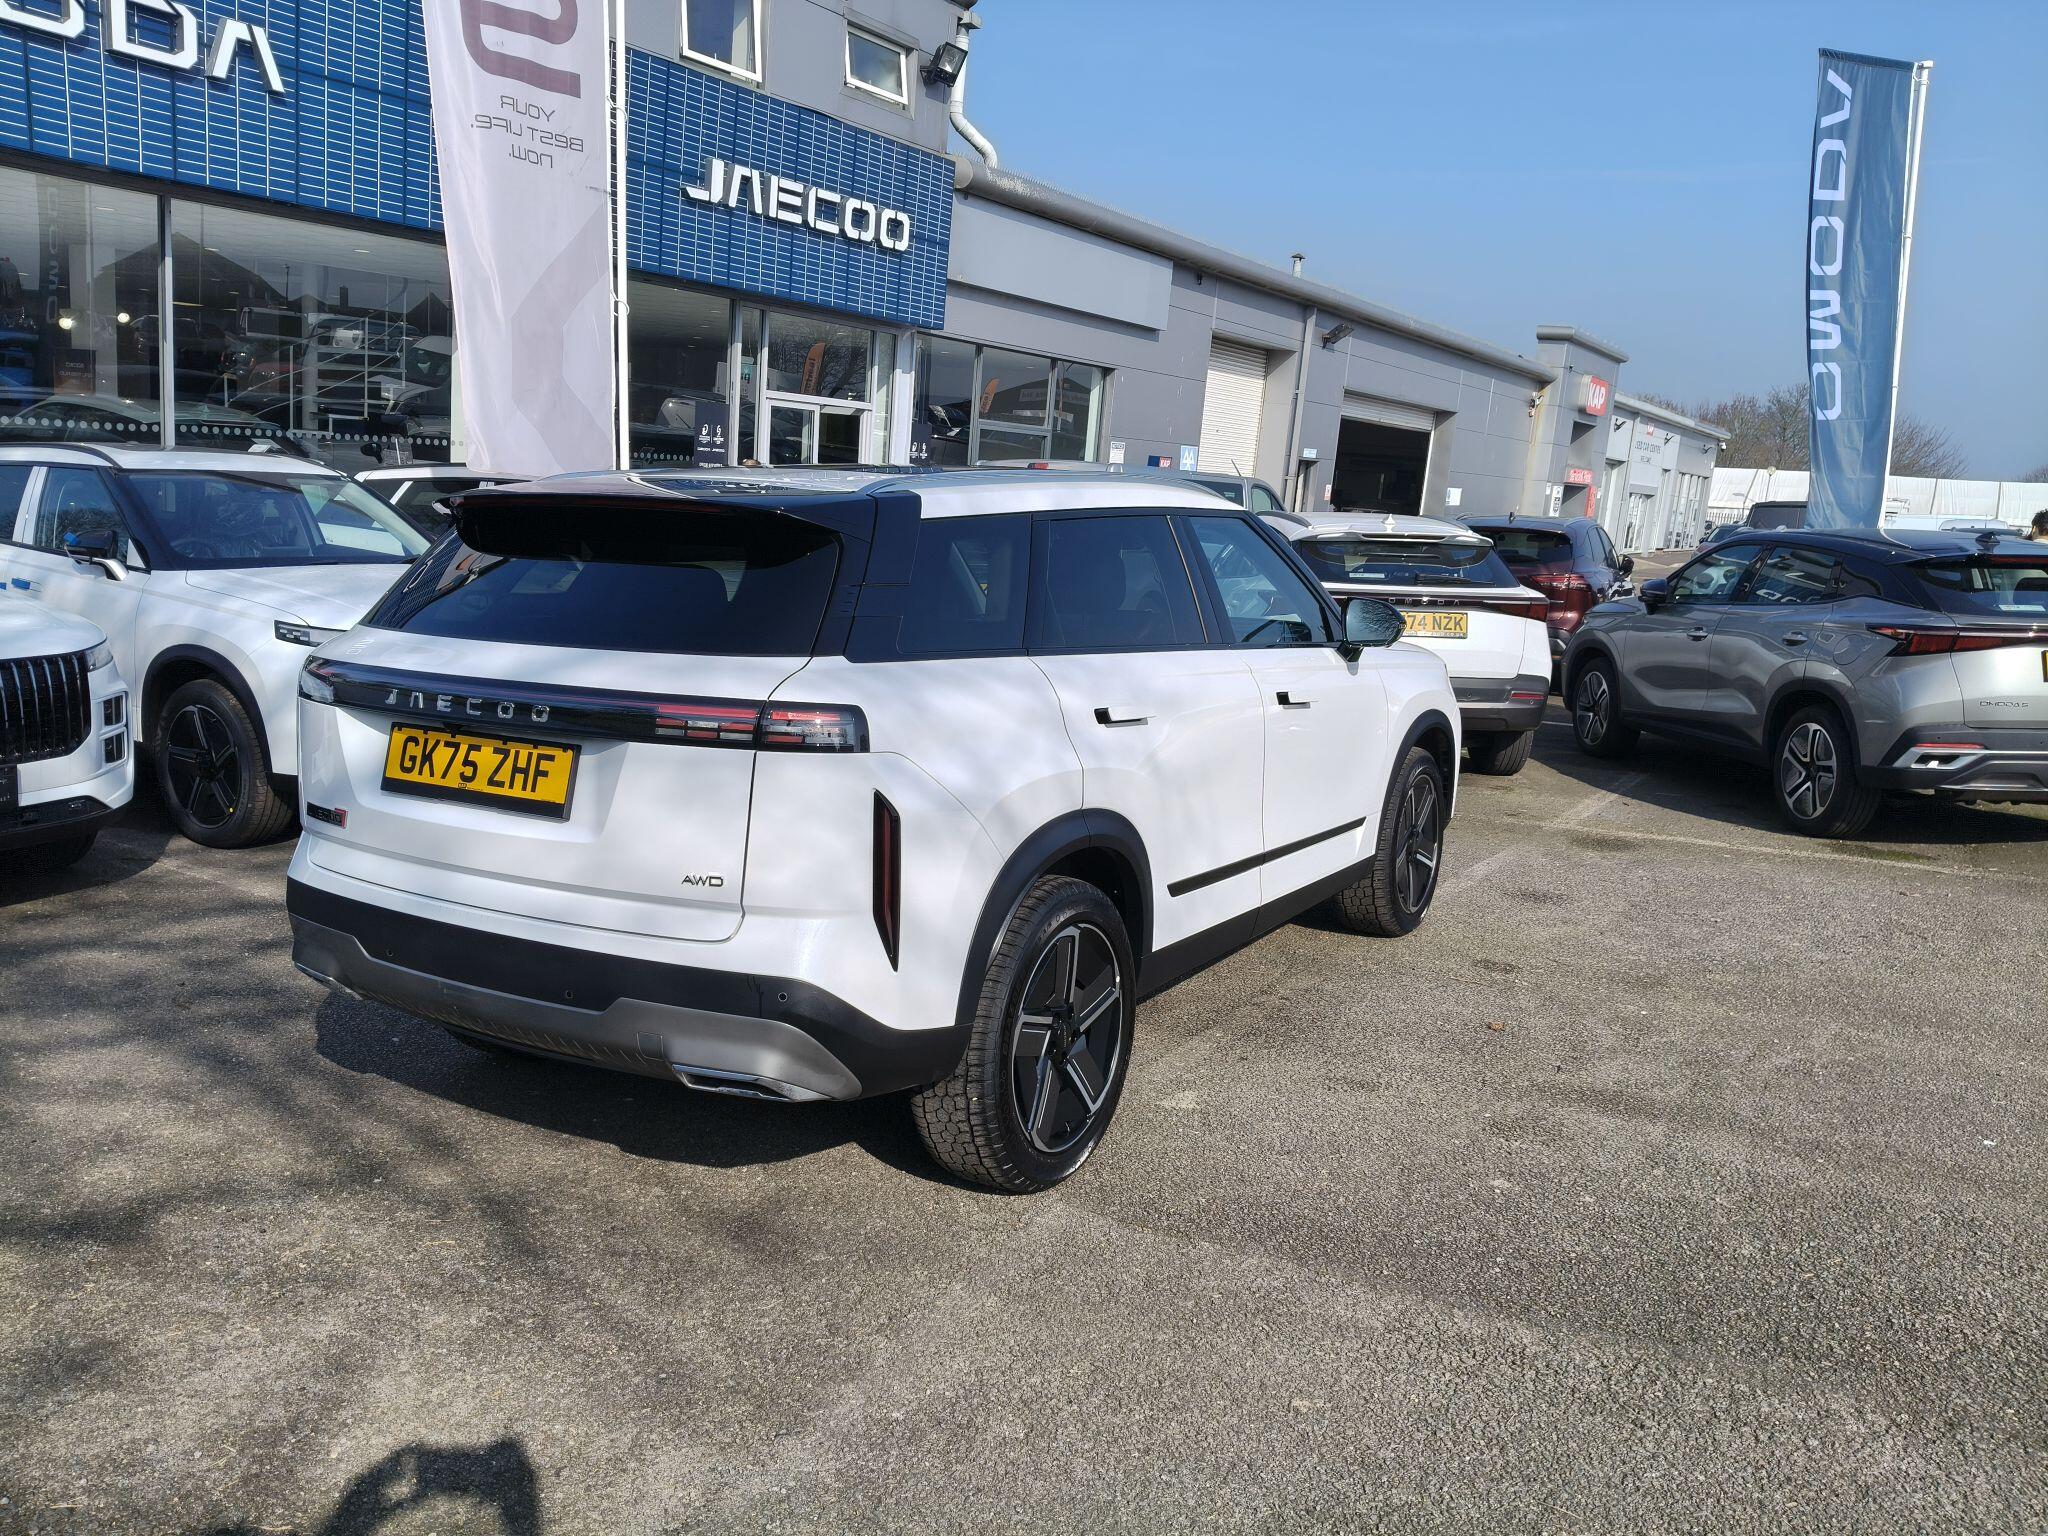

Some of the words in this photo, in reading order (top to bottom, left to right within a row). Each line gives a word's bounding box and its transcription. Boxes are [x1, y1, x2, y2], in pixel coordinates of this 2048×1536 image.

[682, 157, 911, 251] JAECOO
[1587, 382, 1606, 410] KAP
[1403, 614, 1427, 630] 74
[1432, 615, 1464, 631] NZK
[384, 688, 550, 723] JAECOO
[399, 735, 482, 783] GK75
[486, 747, 556, 793] ZHF
[681, 874, 724, 887] AWD
